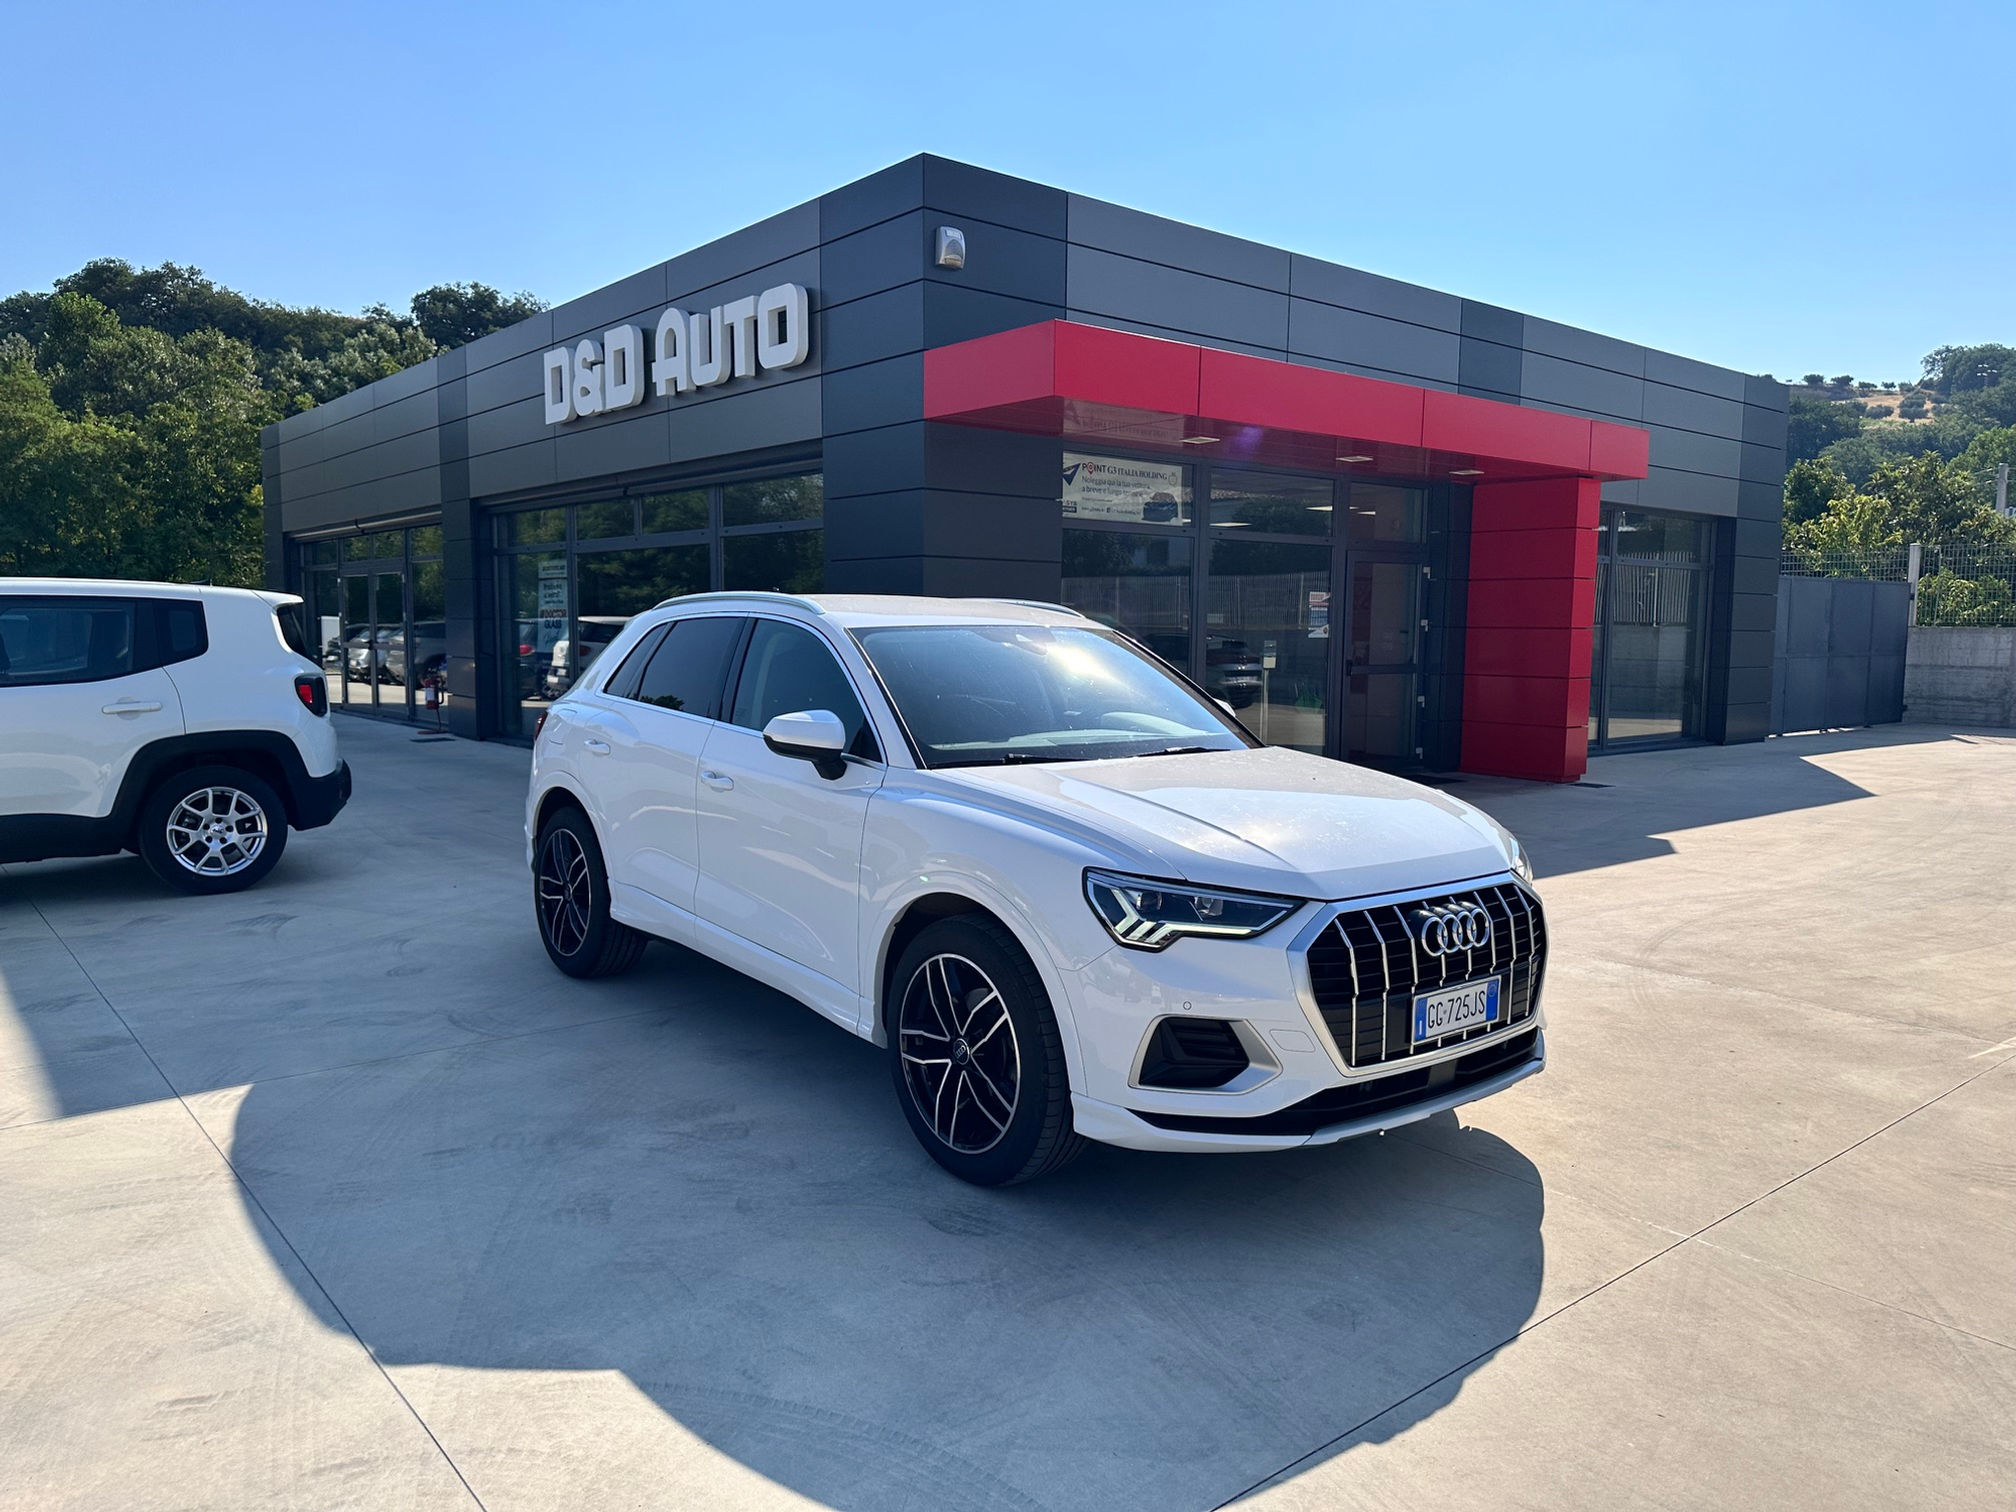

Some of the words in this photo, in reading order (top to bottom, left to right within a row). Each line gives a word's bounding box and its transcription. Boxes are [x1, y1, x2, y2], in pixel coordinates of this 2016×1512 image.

[543, 324, 645, 425] D&D
[651, 283, 809, 397] AUTO
[1082, 462, 1106, 475] POINT
[1117, 467, 1138, 477] ITALIA
[1138, 470, 1168, 480] HOLDING
